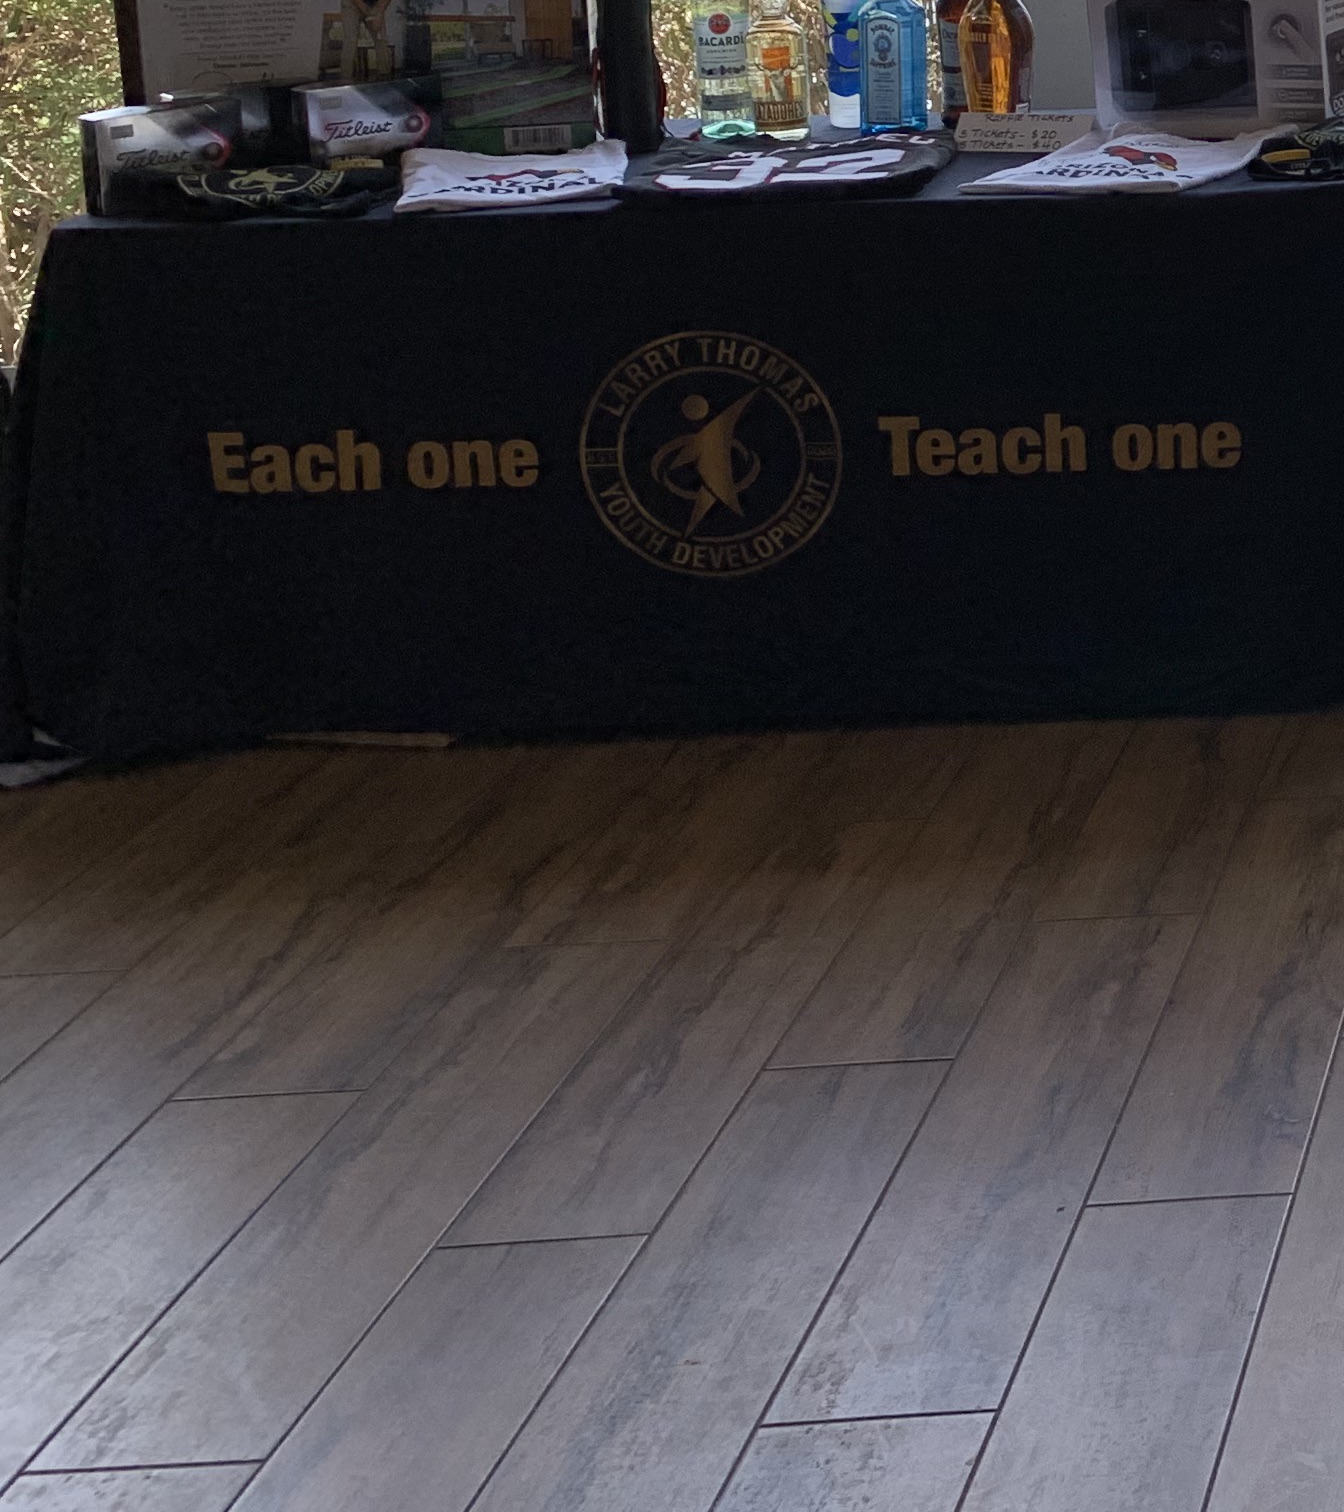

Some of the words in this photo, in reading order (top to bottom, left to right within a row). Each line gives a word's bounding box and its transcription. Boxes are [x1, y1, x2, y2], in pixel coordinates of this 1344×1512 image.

[114, 149, 190, 170] Titleist
[323, 119, 393, 143] Titleist
[1031, 130, 1058, 139] $20
[598, 340, 683, 418] LARRY
[695, 338, 821, 413] THOMAS
[206, 427, 383, 494] Each
[406, 438, 541, 489] one
[876, 412, 1088, 477] Teach
[1112, 420, 1243, 472] one
[600, 481, 666, 555] YOUTH
[671, 471, 831, 569] DEVELOPMENT
